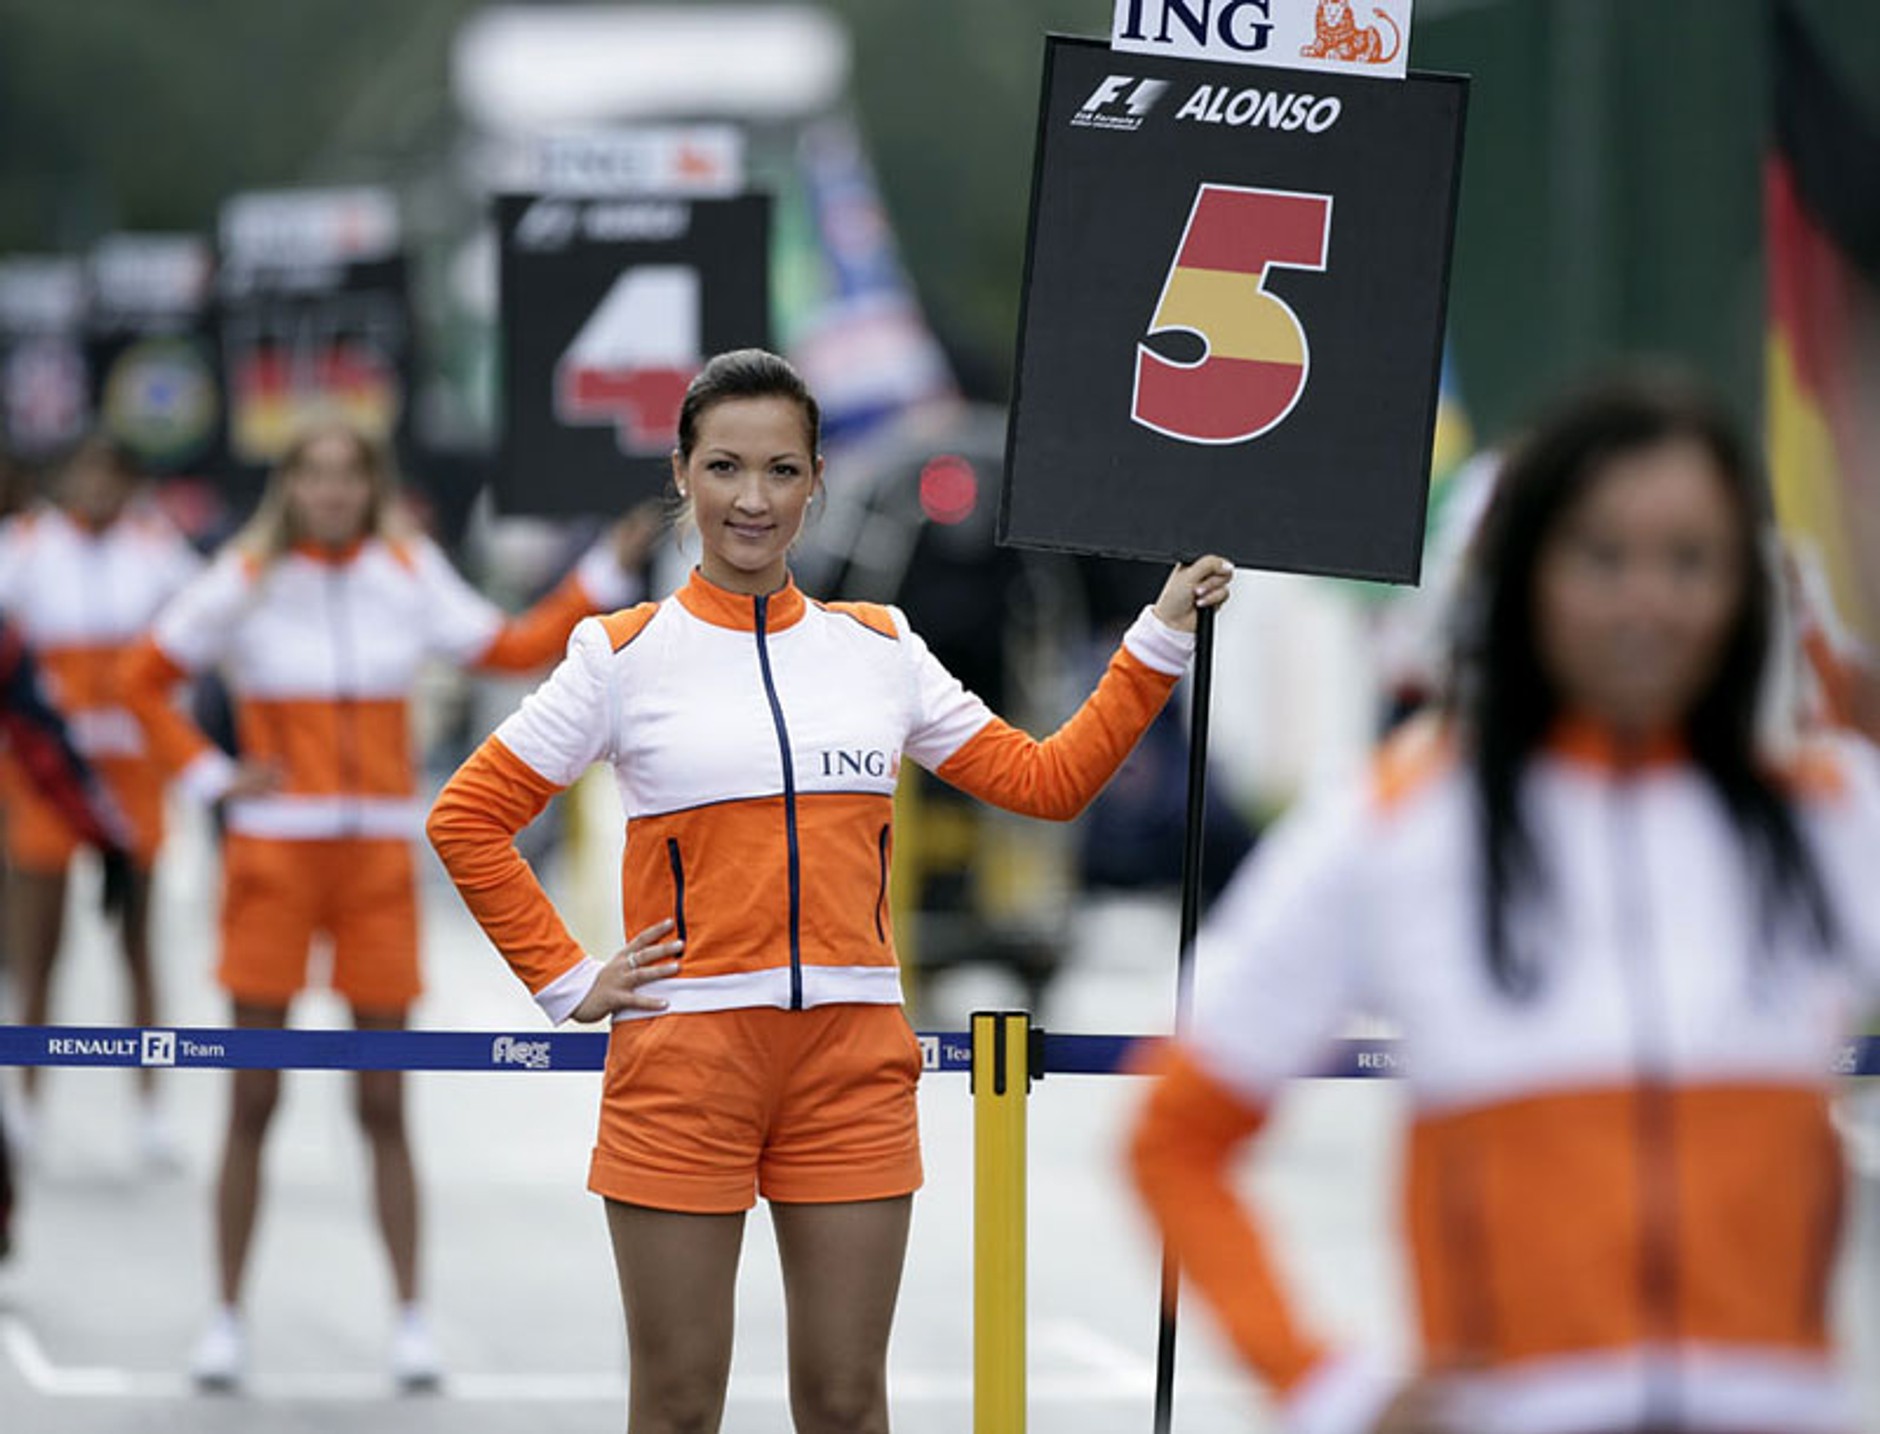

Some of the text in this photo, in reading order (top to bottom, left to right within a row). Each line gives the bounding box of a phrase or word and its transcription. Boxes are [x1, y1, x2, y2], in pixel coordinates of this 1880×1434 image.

[1119, 0, 1274, 52] ING
[1175, 84, 1342, 133] ALONSO
[1131, 183, 1333, 445] 5
[552, 264, 703, 458] 4
[822, 750, 885, 777] ING
[48, 1039, 138, 1055] RENAULT
[180, 1041, 225, 1058] Team
[943, 1045, 971, 1062] Tea
